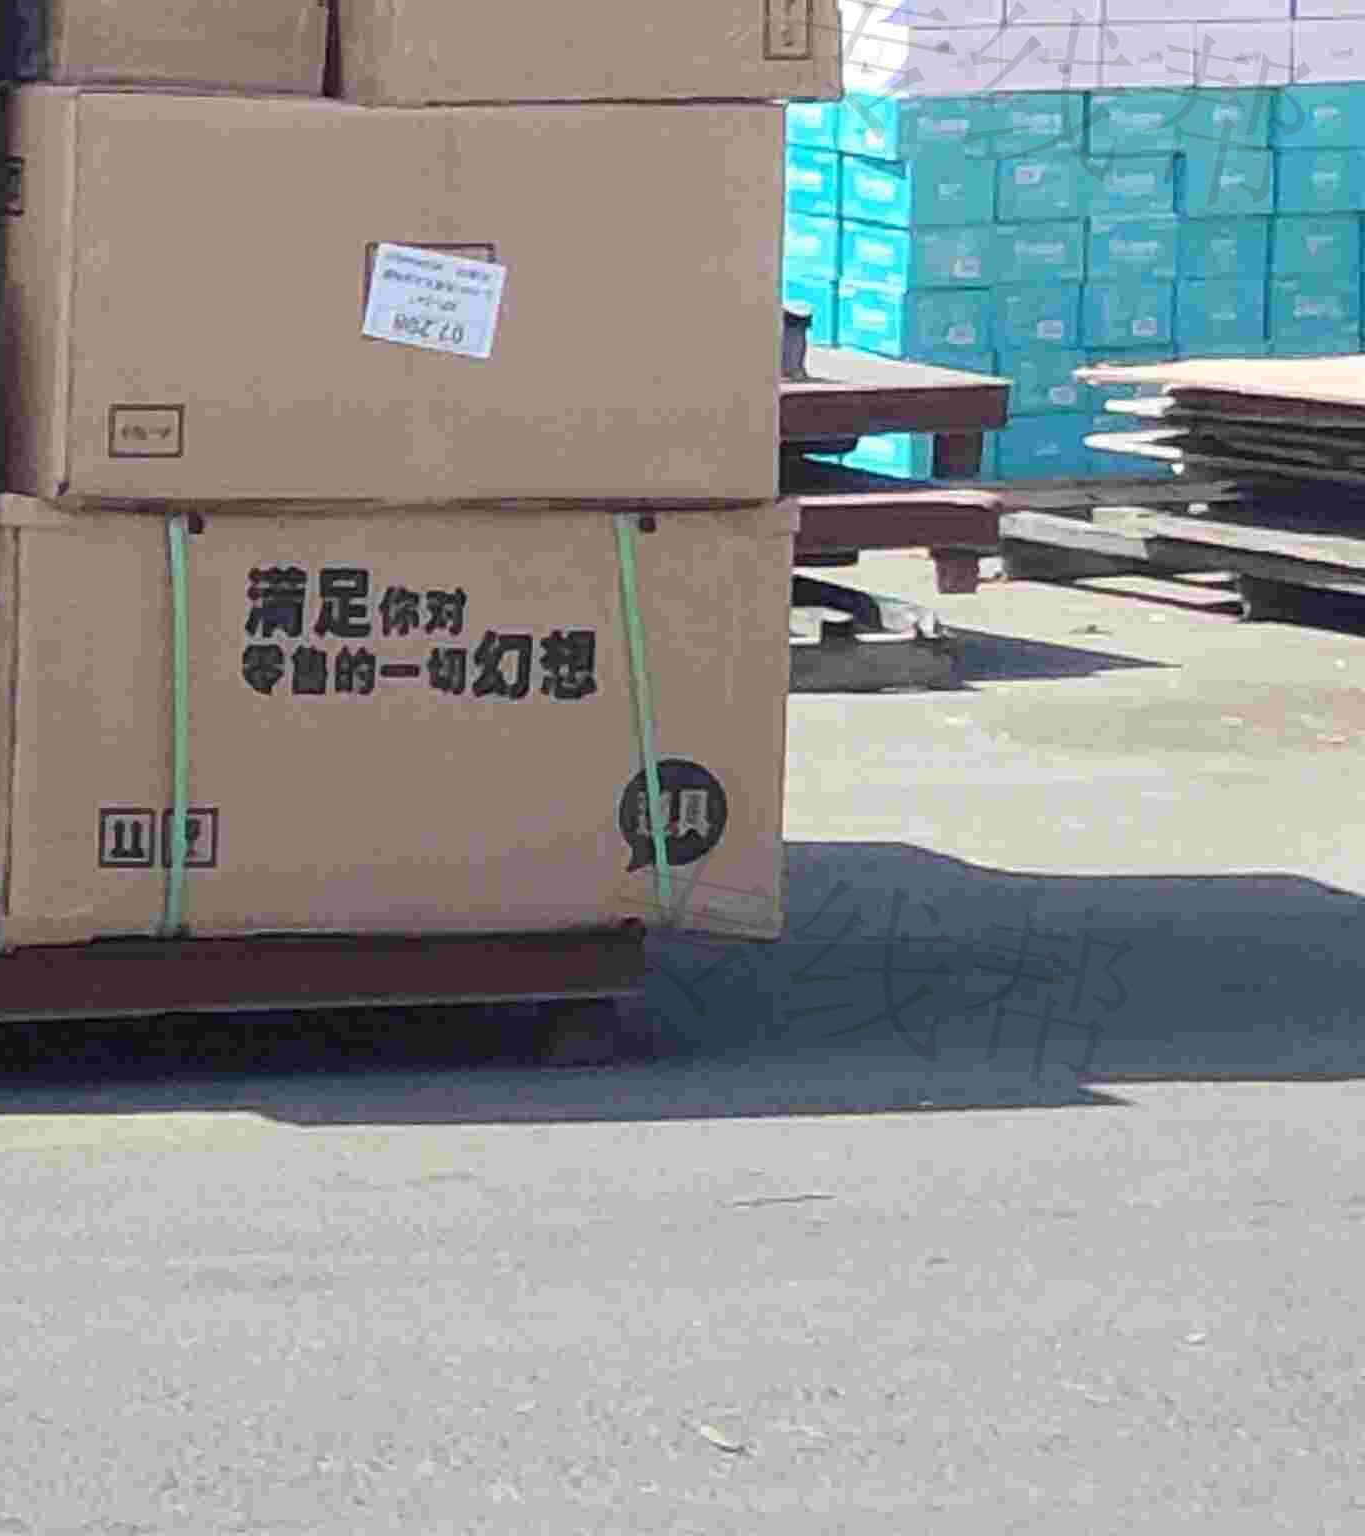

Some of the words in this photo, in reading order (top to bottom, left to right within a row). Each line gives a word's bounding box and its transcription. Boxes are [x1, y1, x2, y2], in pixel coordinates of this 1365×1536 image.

[245, 566, 468, 639] 满足你对
[242, 629, 598, 700] 零售的一切幻想
